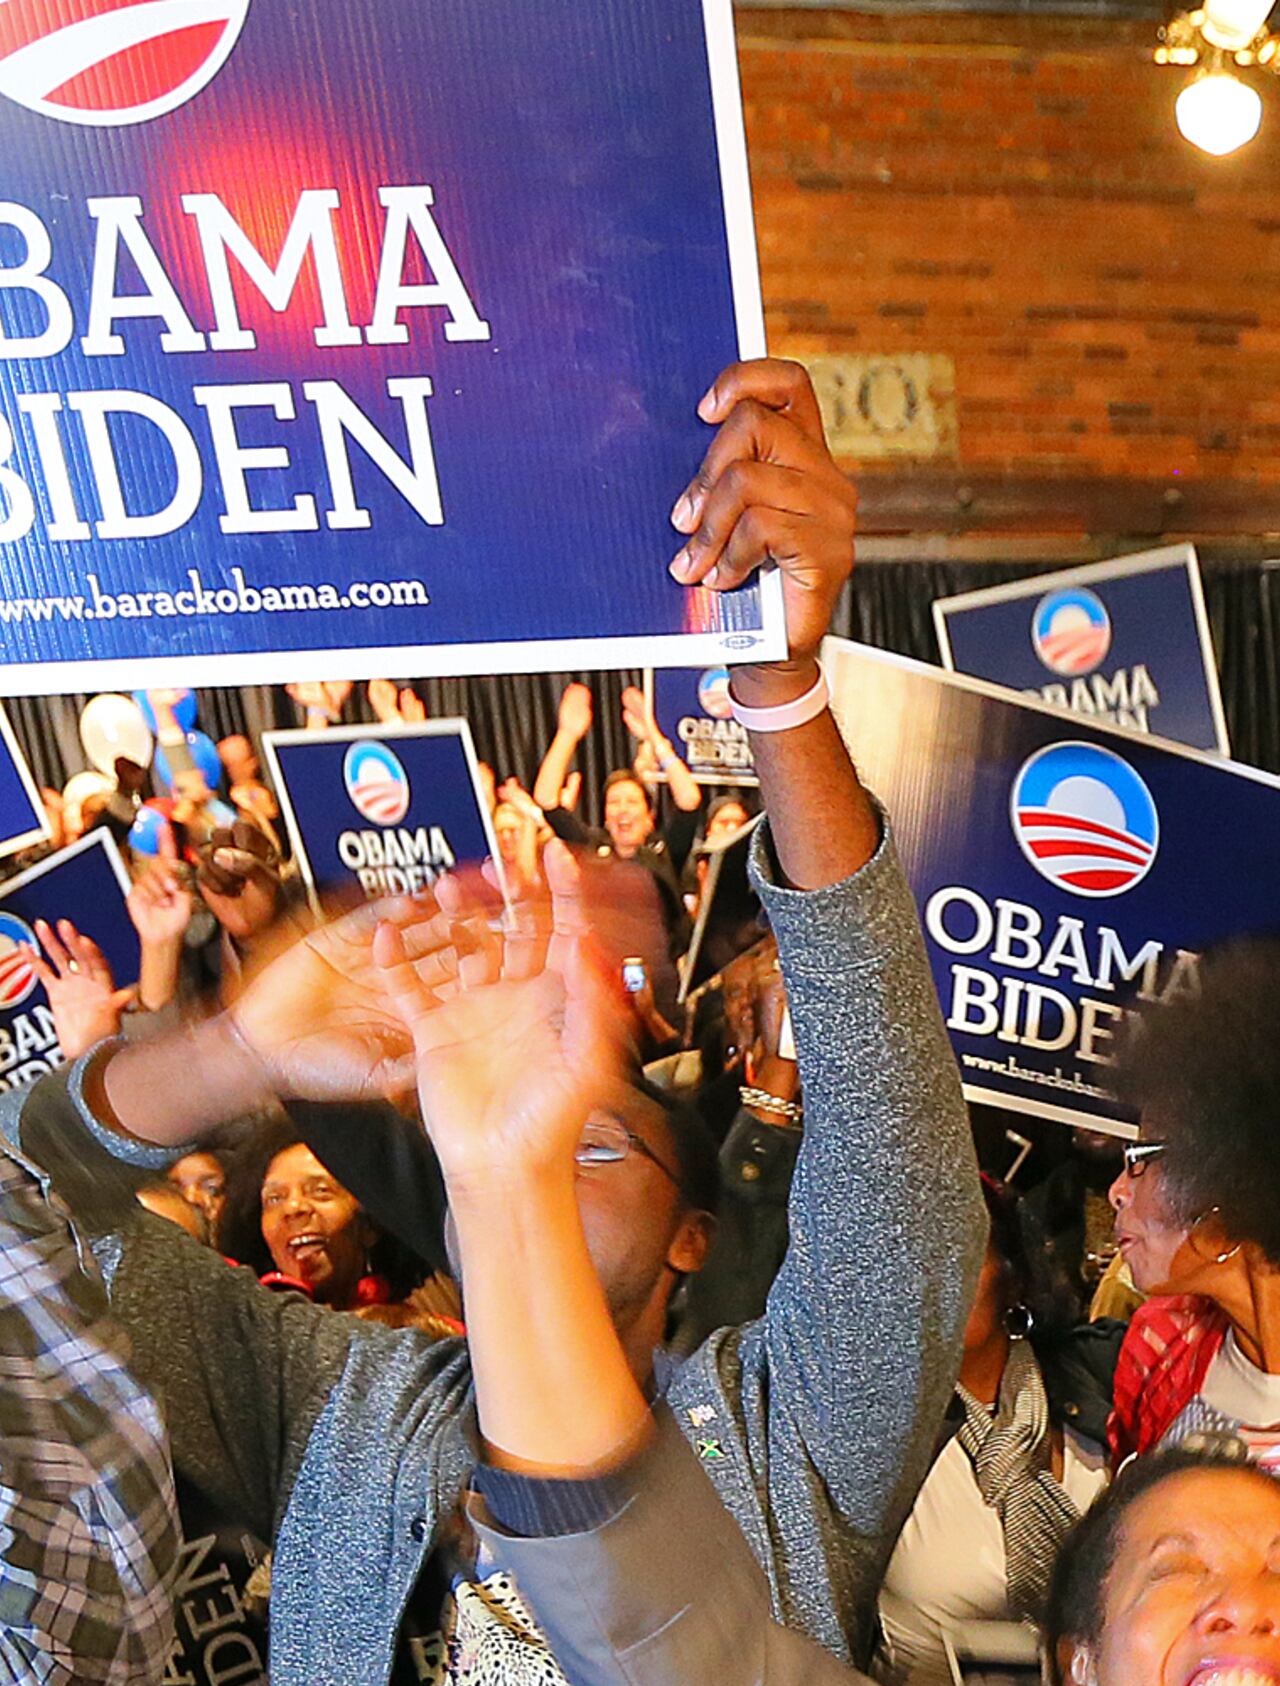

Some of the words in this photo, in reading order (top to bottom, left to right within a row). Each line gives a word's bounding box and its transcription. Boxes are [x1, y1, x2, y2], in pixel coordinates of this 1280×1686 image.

[1022, 664, 1159, 714] BAMA
[678, 716, 749, 743] OBAM
[338, 826, 456, 871] OBAMA
[925, 886, 1204, 1005] OBAMA
